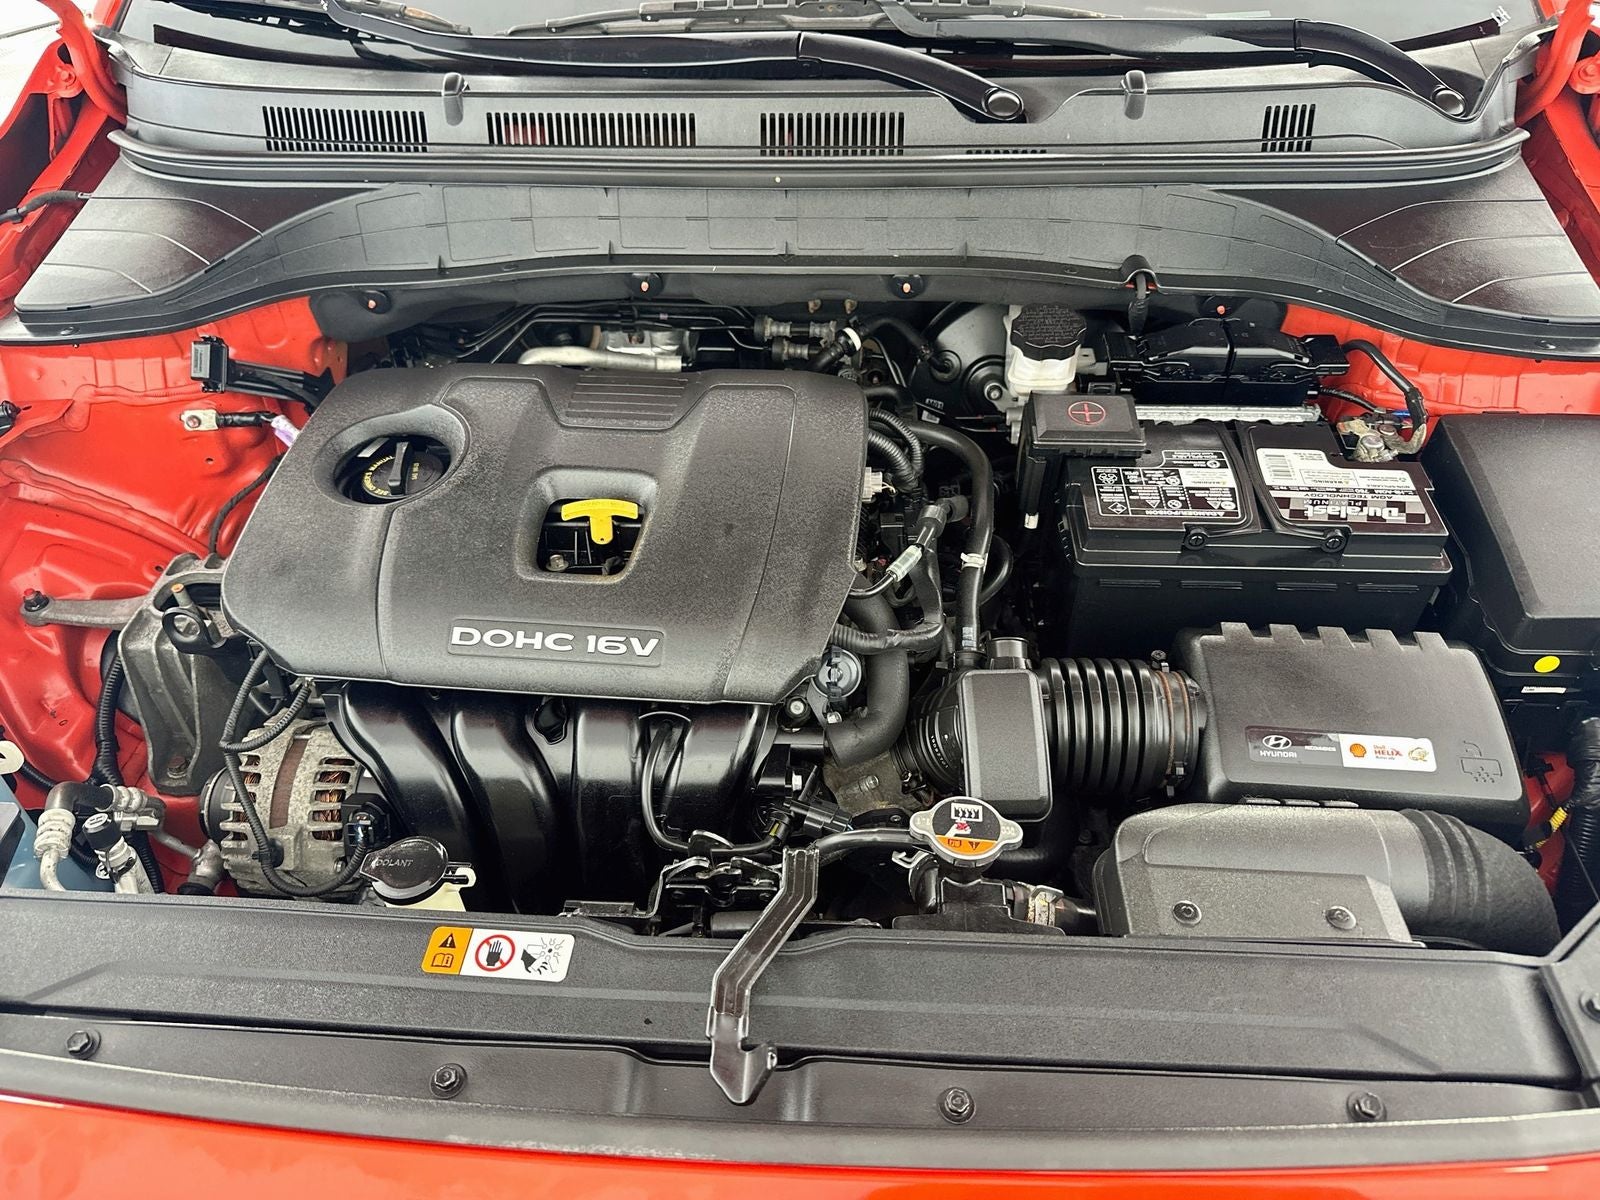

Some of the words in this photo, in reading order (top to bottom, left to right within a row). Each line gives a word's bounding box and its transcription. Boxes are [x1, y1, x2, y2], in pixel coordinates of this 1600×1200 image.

[368, 455, 396, 471] MANUAL
[1303, 498, 1362, 506] PLATINUM
[1303, 504, 1406, 520] Duralast
[451, 626, 575, 651] DOHC
[586, 635, 660, 657] 16V
[1260, 750, 1297, 758] HYUNDAI
[1374, 748, 1403, 757] HELIX
